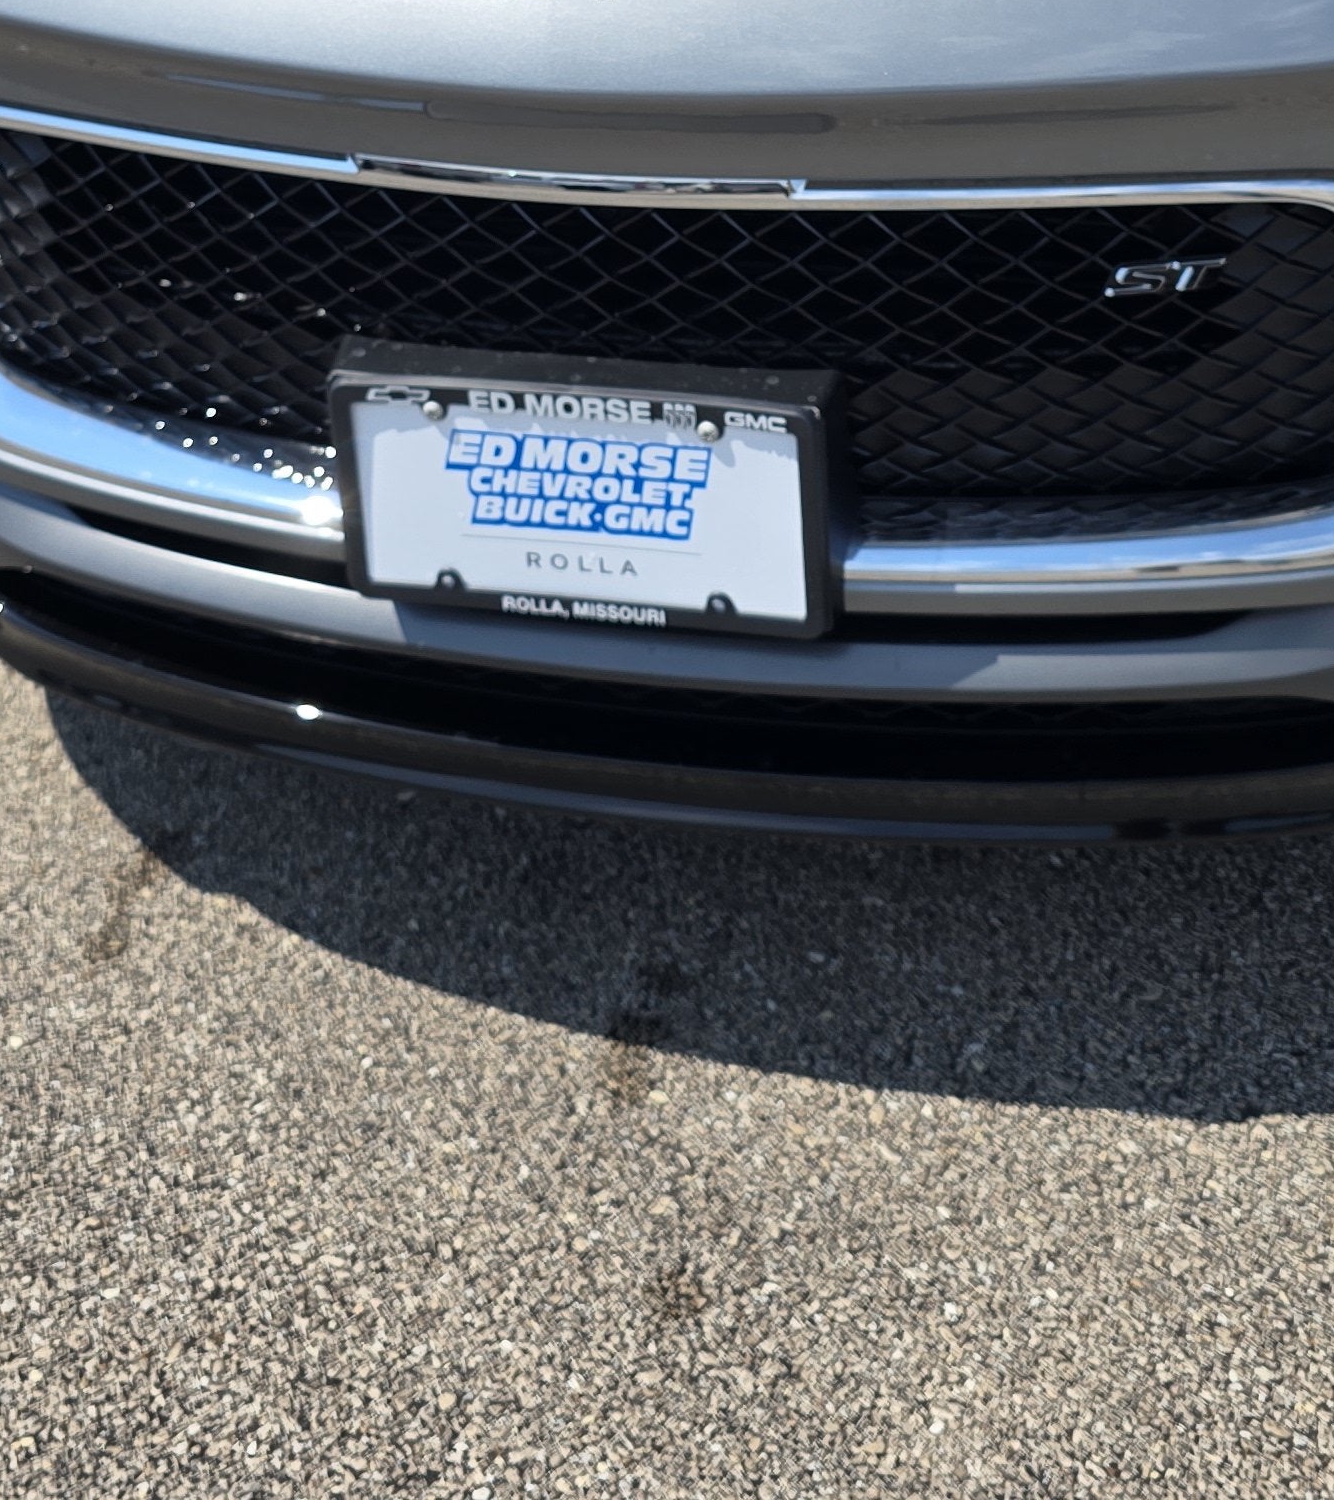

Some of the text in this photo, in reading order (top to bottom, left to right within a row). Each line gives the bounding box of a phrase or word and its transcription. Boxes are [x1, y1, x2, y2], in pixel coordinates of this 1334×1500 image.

[1104, 257, 1227, 298] ST
[468, 389, 653, 425] ED MORSE
[724, 411, 787, 434] GMC
[448, 431, 709, 483] ED MORSE
[470, 466, 691, 507] CHEVROLET
[525, 551, 638, 576] ROLLA
[501, 594, 667, 627] ROLLA, MISSOURI
